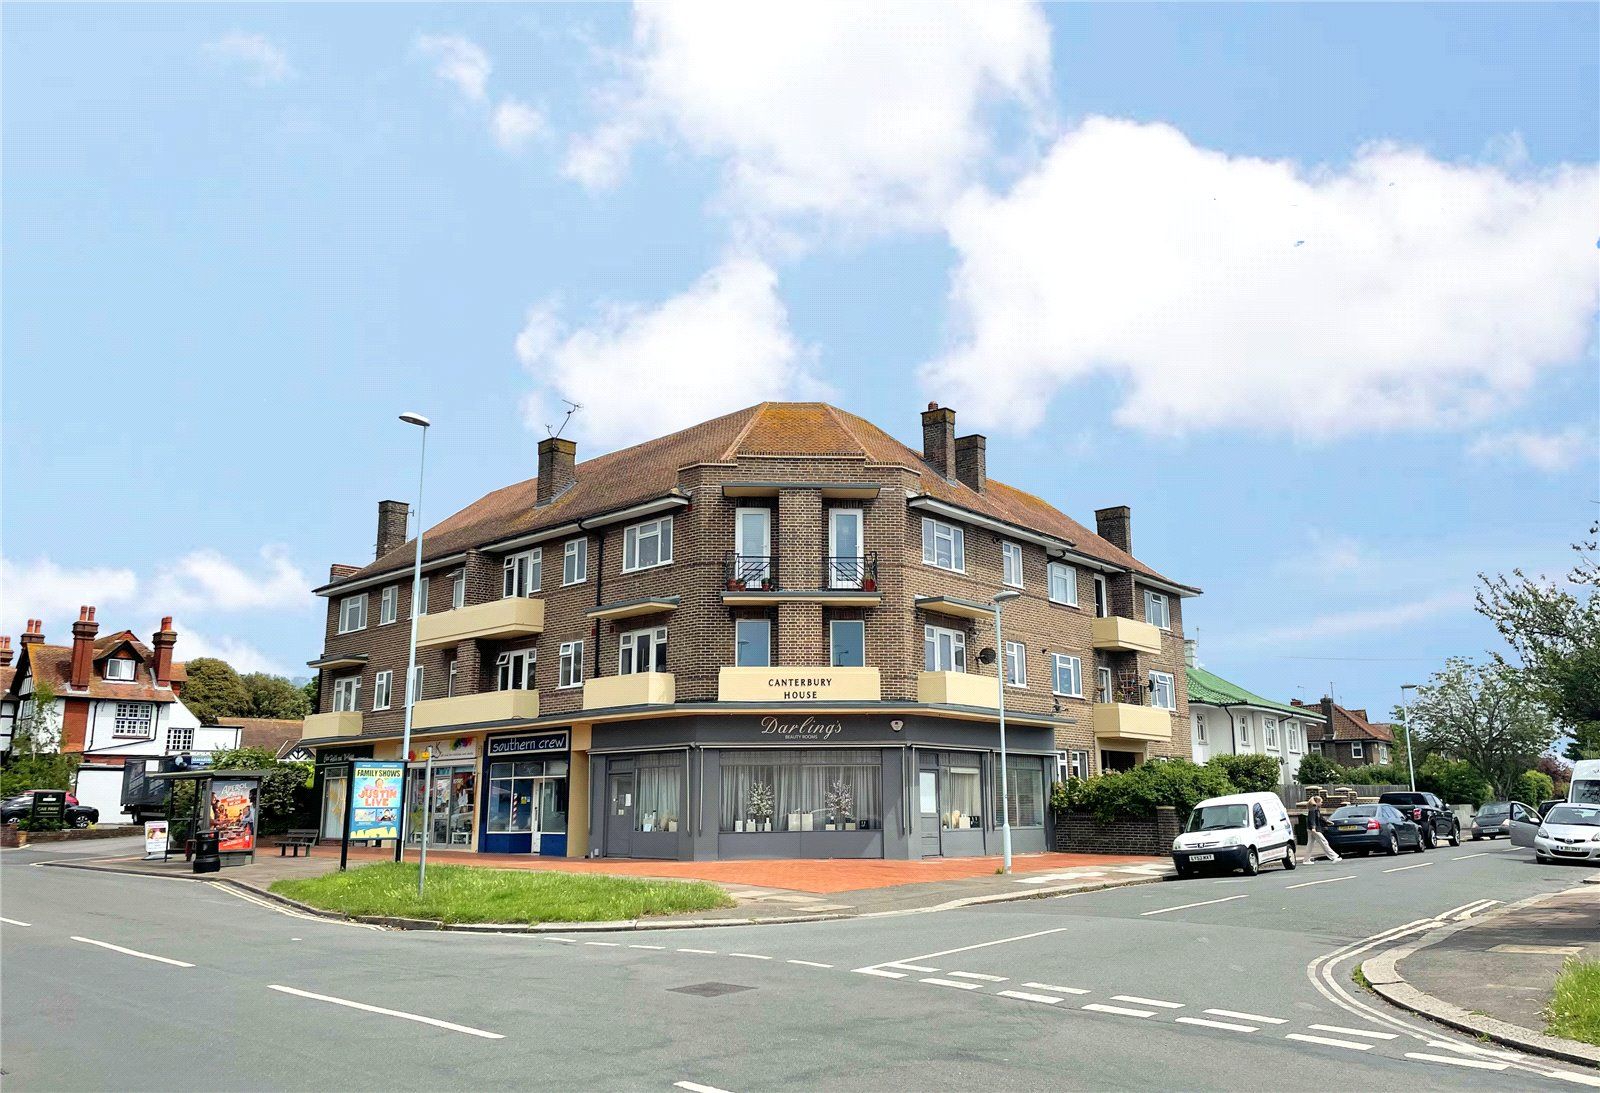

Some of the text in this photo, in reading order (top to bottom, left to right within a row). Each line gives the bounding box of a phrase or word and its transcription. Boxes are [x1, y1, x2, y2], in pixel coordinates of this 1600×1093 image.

[768, 678, 832, 687] CANTERBURY
[784, 691, 818, 699] HOUSE
[761, 716, 842, 739] Darling's
[492, 736, 565, 753] southern crew
[357, 769, 401, 778] FAMILY SHOWS
[358, 789, 397, 798] JUSTIN
[365, 798, 389, 806] LIVE
